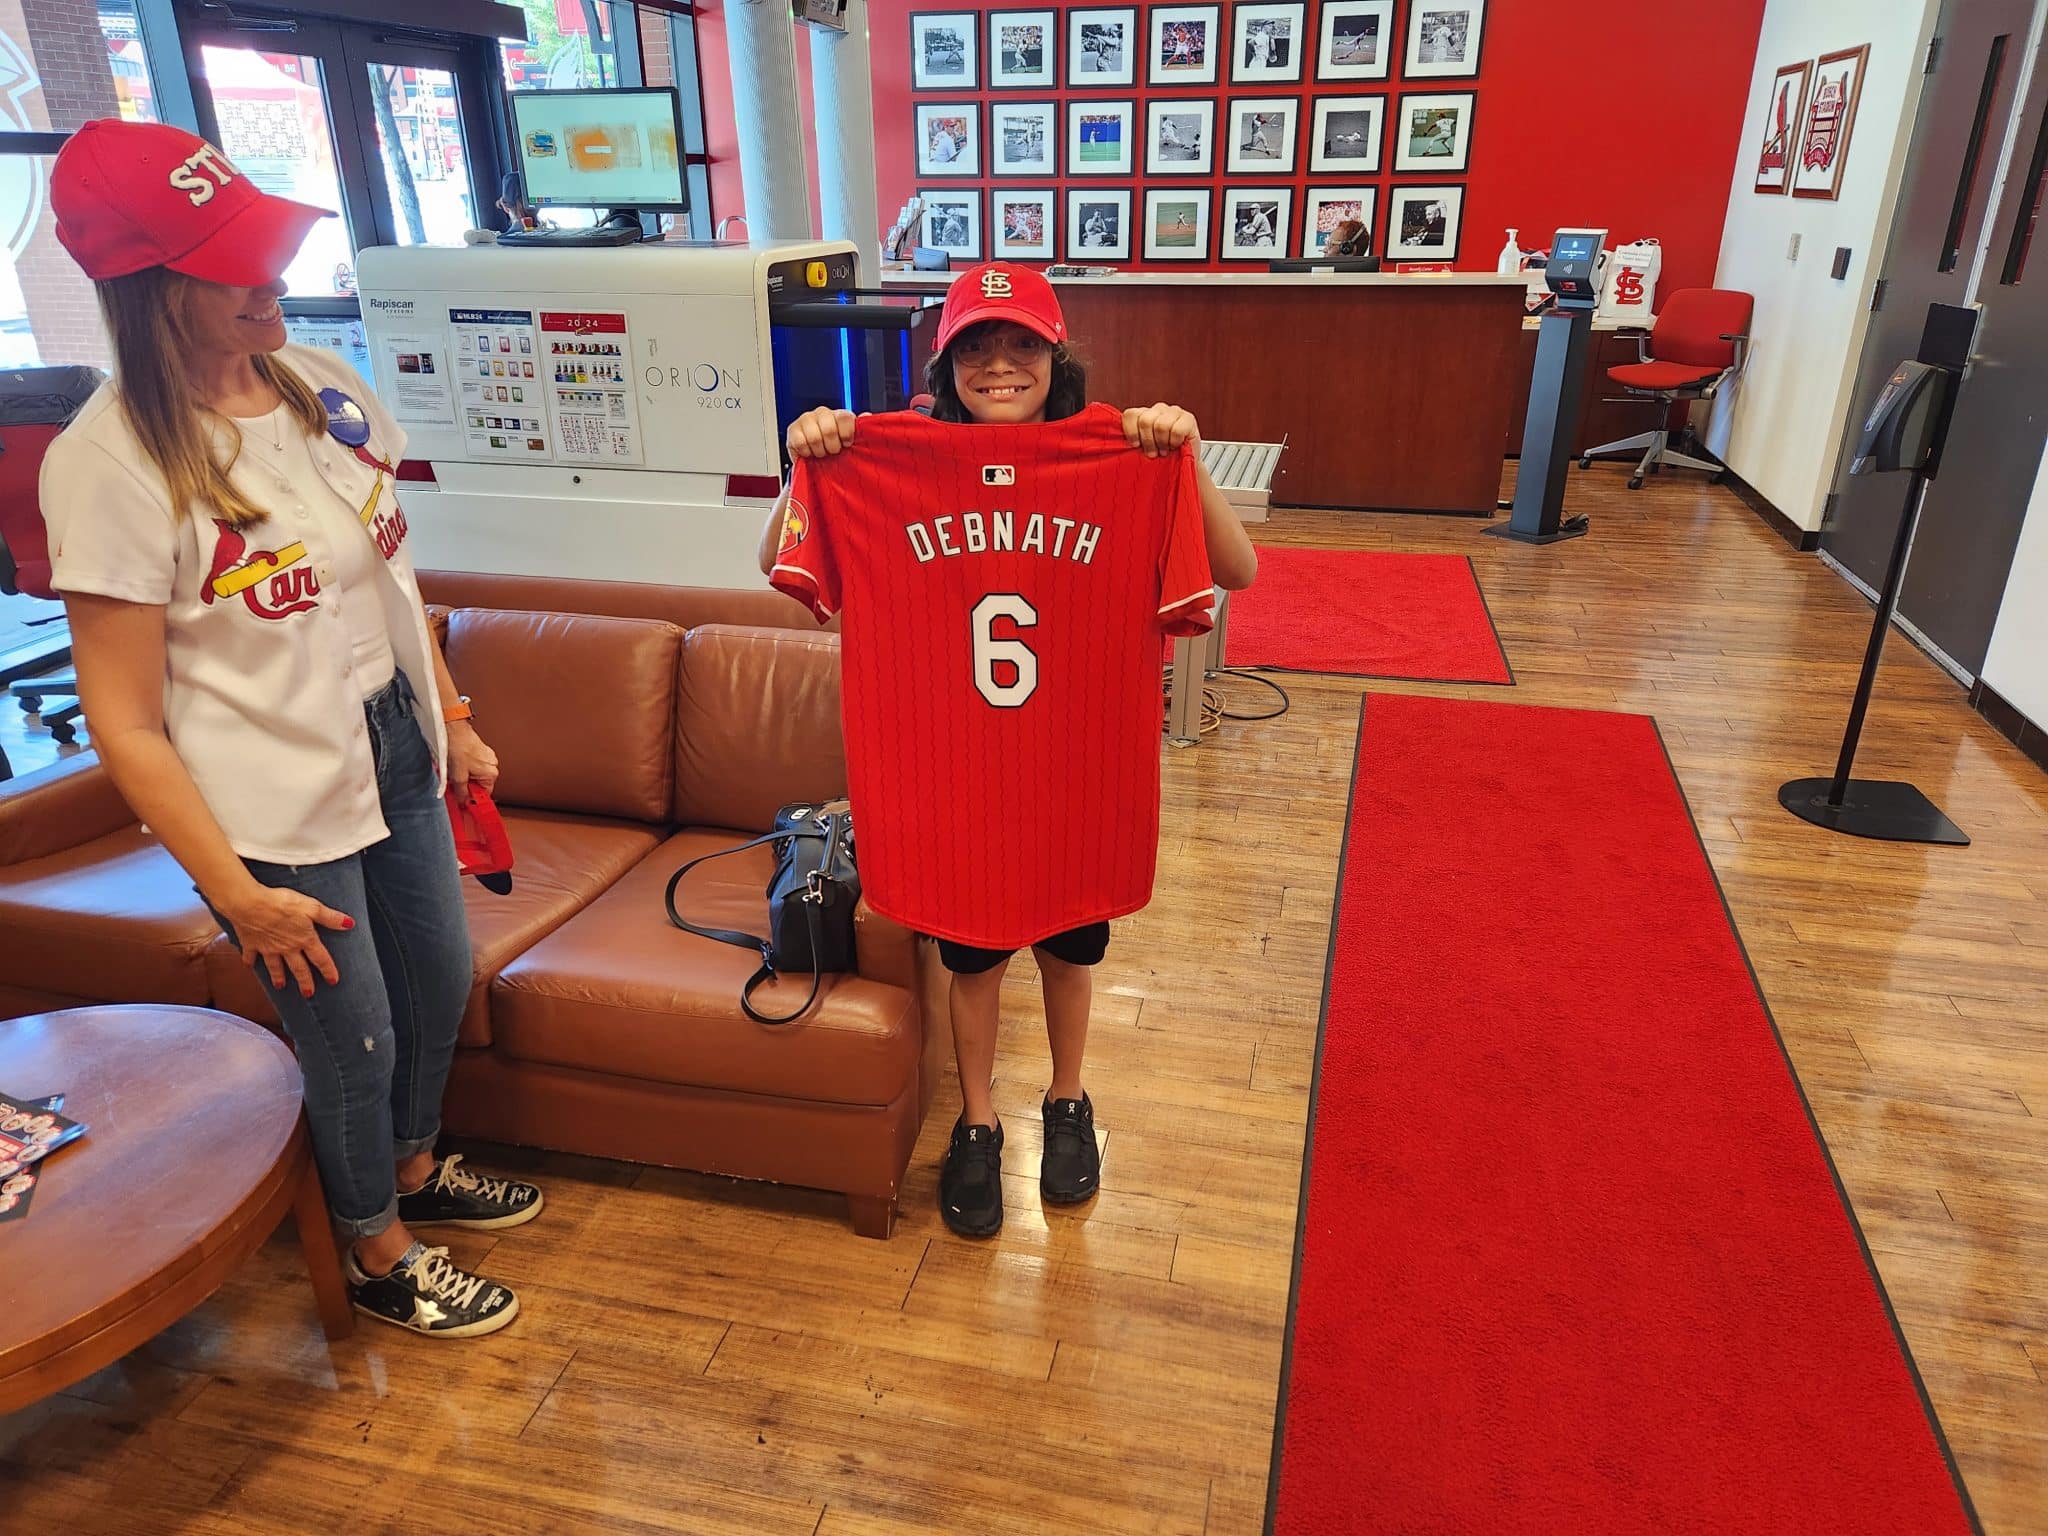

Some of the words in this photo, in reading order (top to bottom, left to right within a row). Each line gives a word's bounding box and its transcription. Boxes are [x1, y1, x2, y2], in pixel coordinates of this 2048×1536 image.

[370, 298, 414, 310] Rapiscan
[645, 363, 740, 392] ORION
[697, 396, 722, 408] 920
[725, 397, 741, 409] CX
[905, 510, 1103, 566] DEBNATH
[970, 592, 1039, 708] 6
